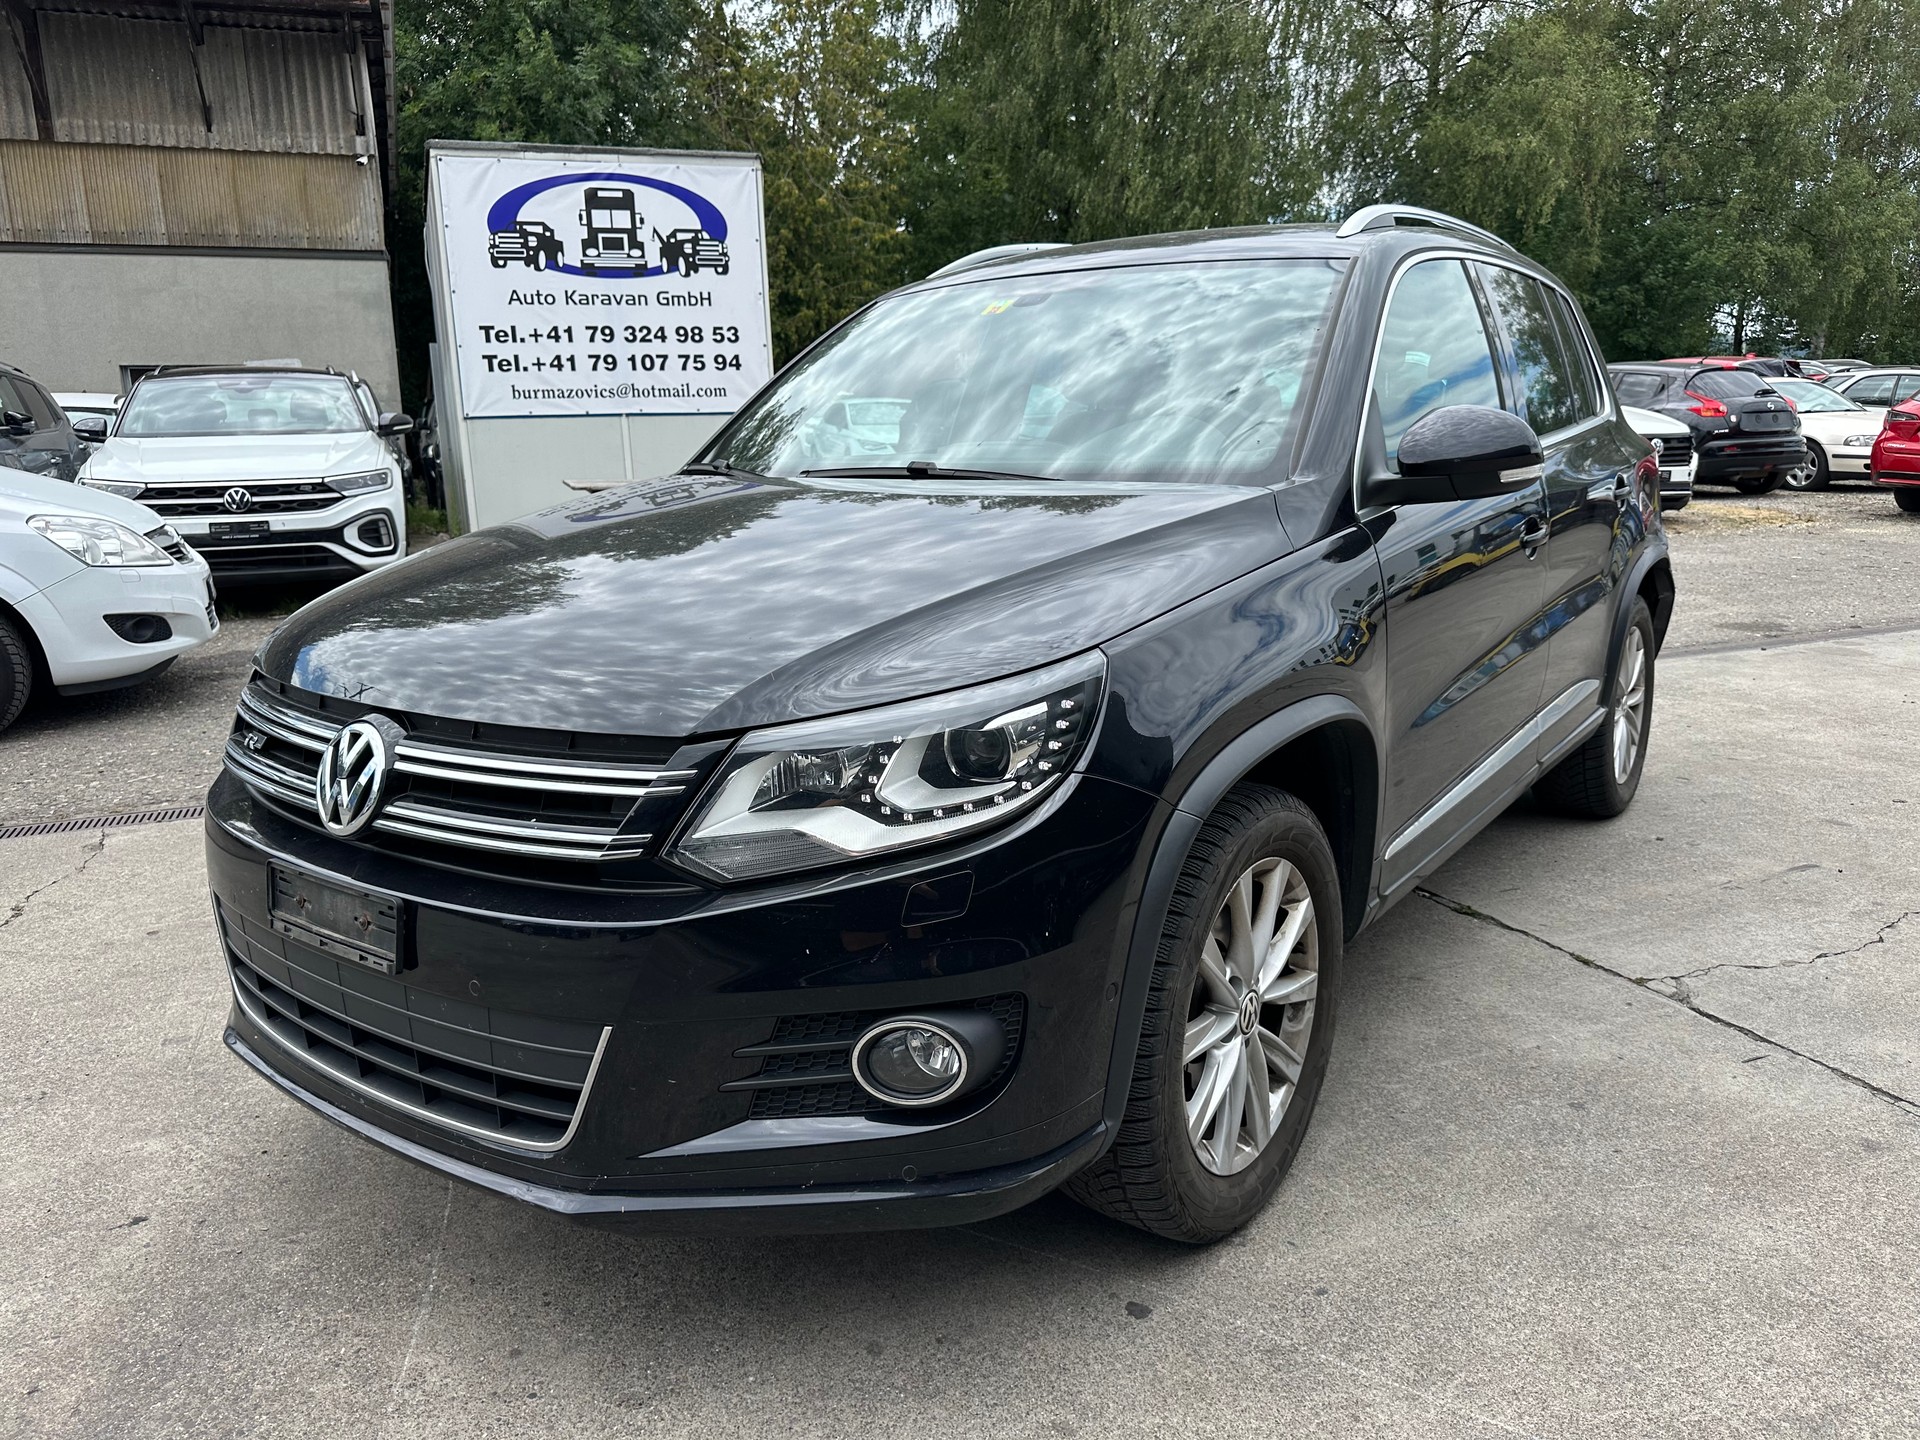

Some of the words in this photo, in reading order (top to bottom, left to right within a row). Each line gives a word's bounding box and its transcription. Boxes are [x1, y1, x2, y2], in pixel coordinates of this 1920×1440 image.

[508, 289, 556, 305] Auto
[564, 290, 649, 306] Karavan
[656, 291, 712, 307] GmbH
[478, 325, 574, 343] Tel.+41
[585, 325, 615, 343] 79
[623, 325, 668, 343] 324
[675, 326, 704, 343] 98
[712, 326, 740, 343] 53
[481, 354, 577, 372] Tel.+41
[587, 354, 618, 371] 79
[627, 354, 669, 371] 107
[677, 354, 706, 371] 75
[713, 354, 742, 371] 94
[511, 383, 727, 400] burmazovics@hotmail.com
[224, 487, 251, 512] VW
[319, 724, 383, 833] VW
